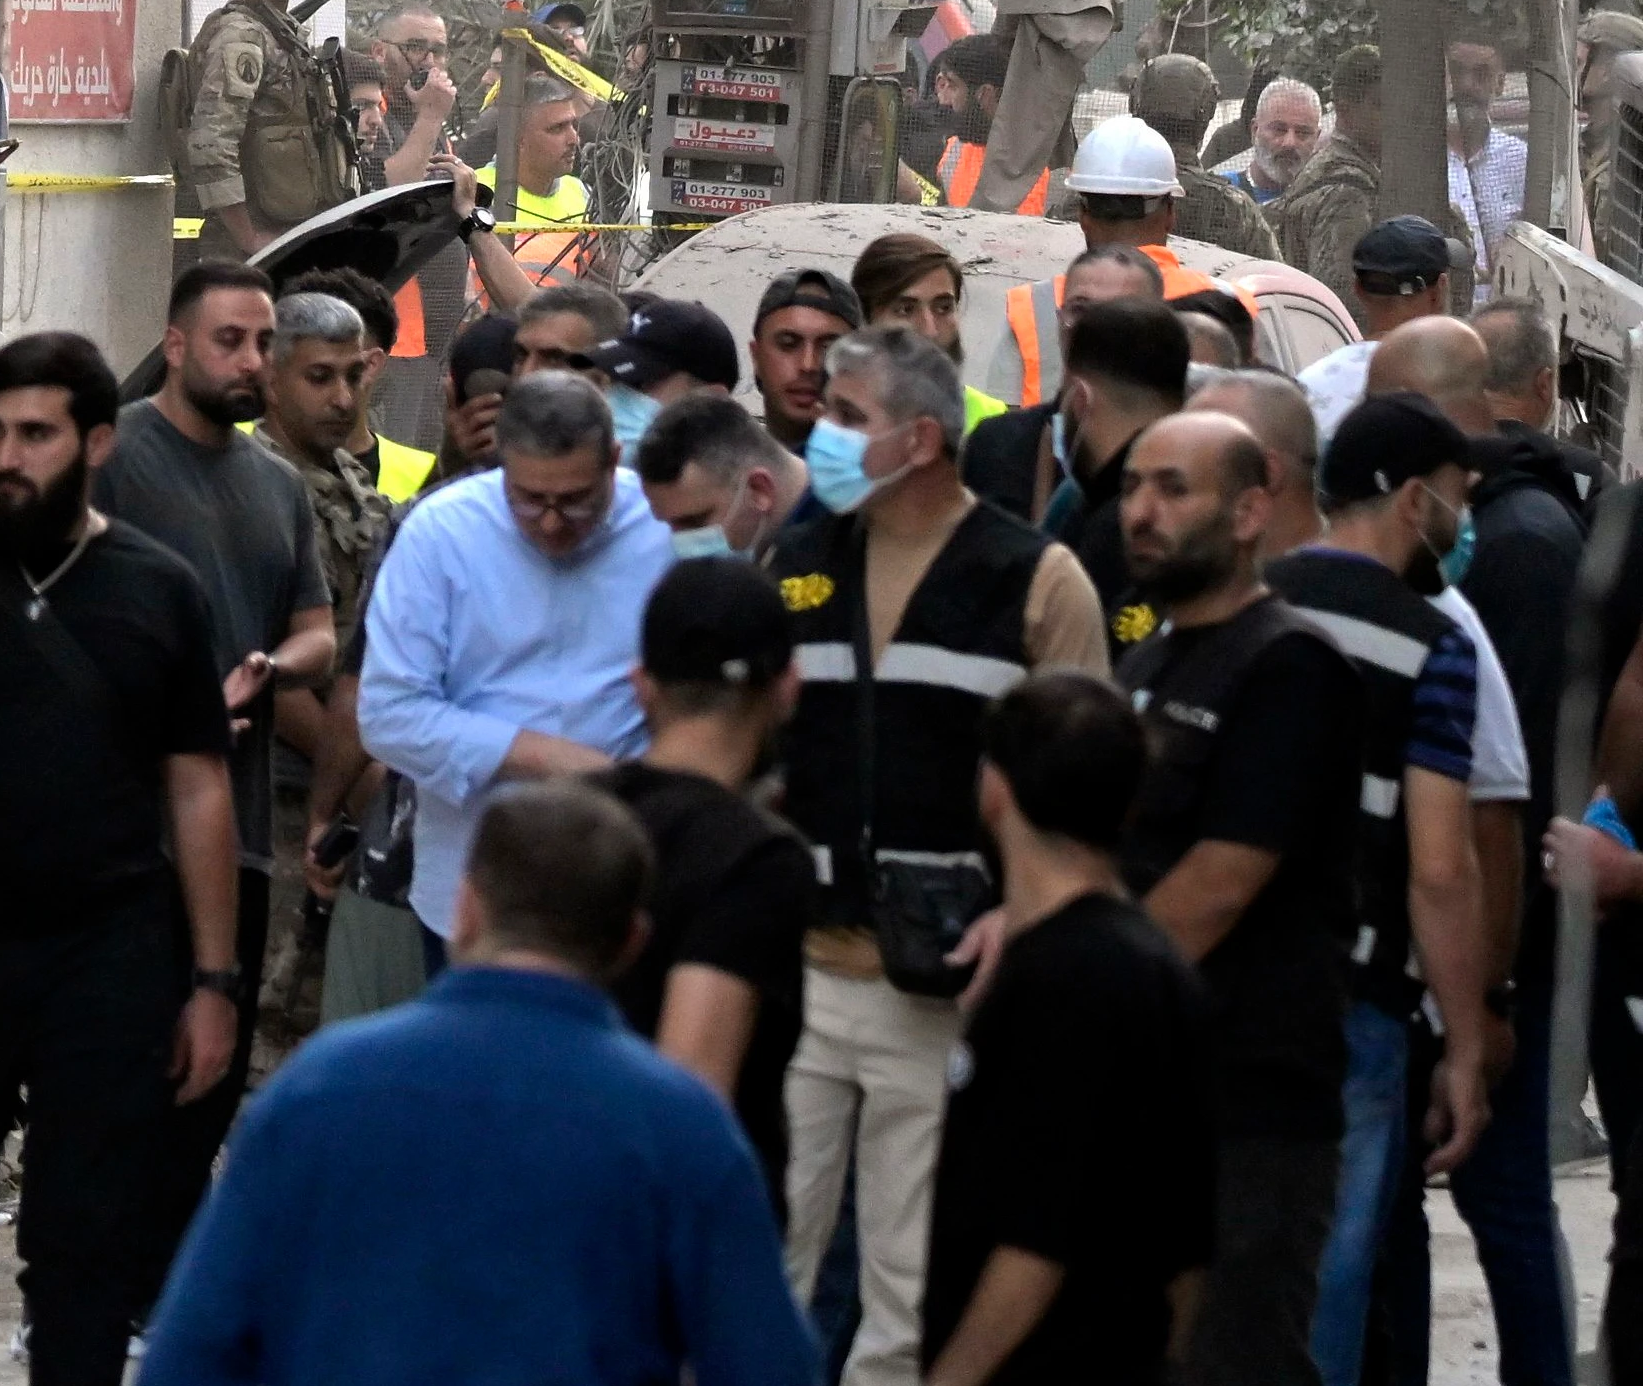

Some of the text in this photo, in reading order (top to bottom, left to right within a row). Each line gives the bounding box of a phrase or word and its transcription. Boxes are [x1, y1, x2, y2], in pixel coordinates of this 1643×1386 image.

[11, 48, 110, 107] بلدية حارة حريك
[751, 74, 775, 84] 903
[750, 88, 774, 98] 501
[690, 184, 766, 199] 01-277 903
[689, 197, 736, 210] 03-047
